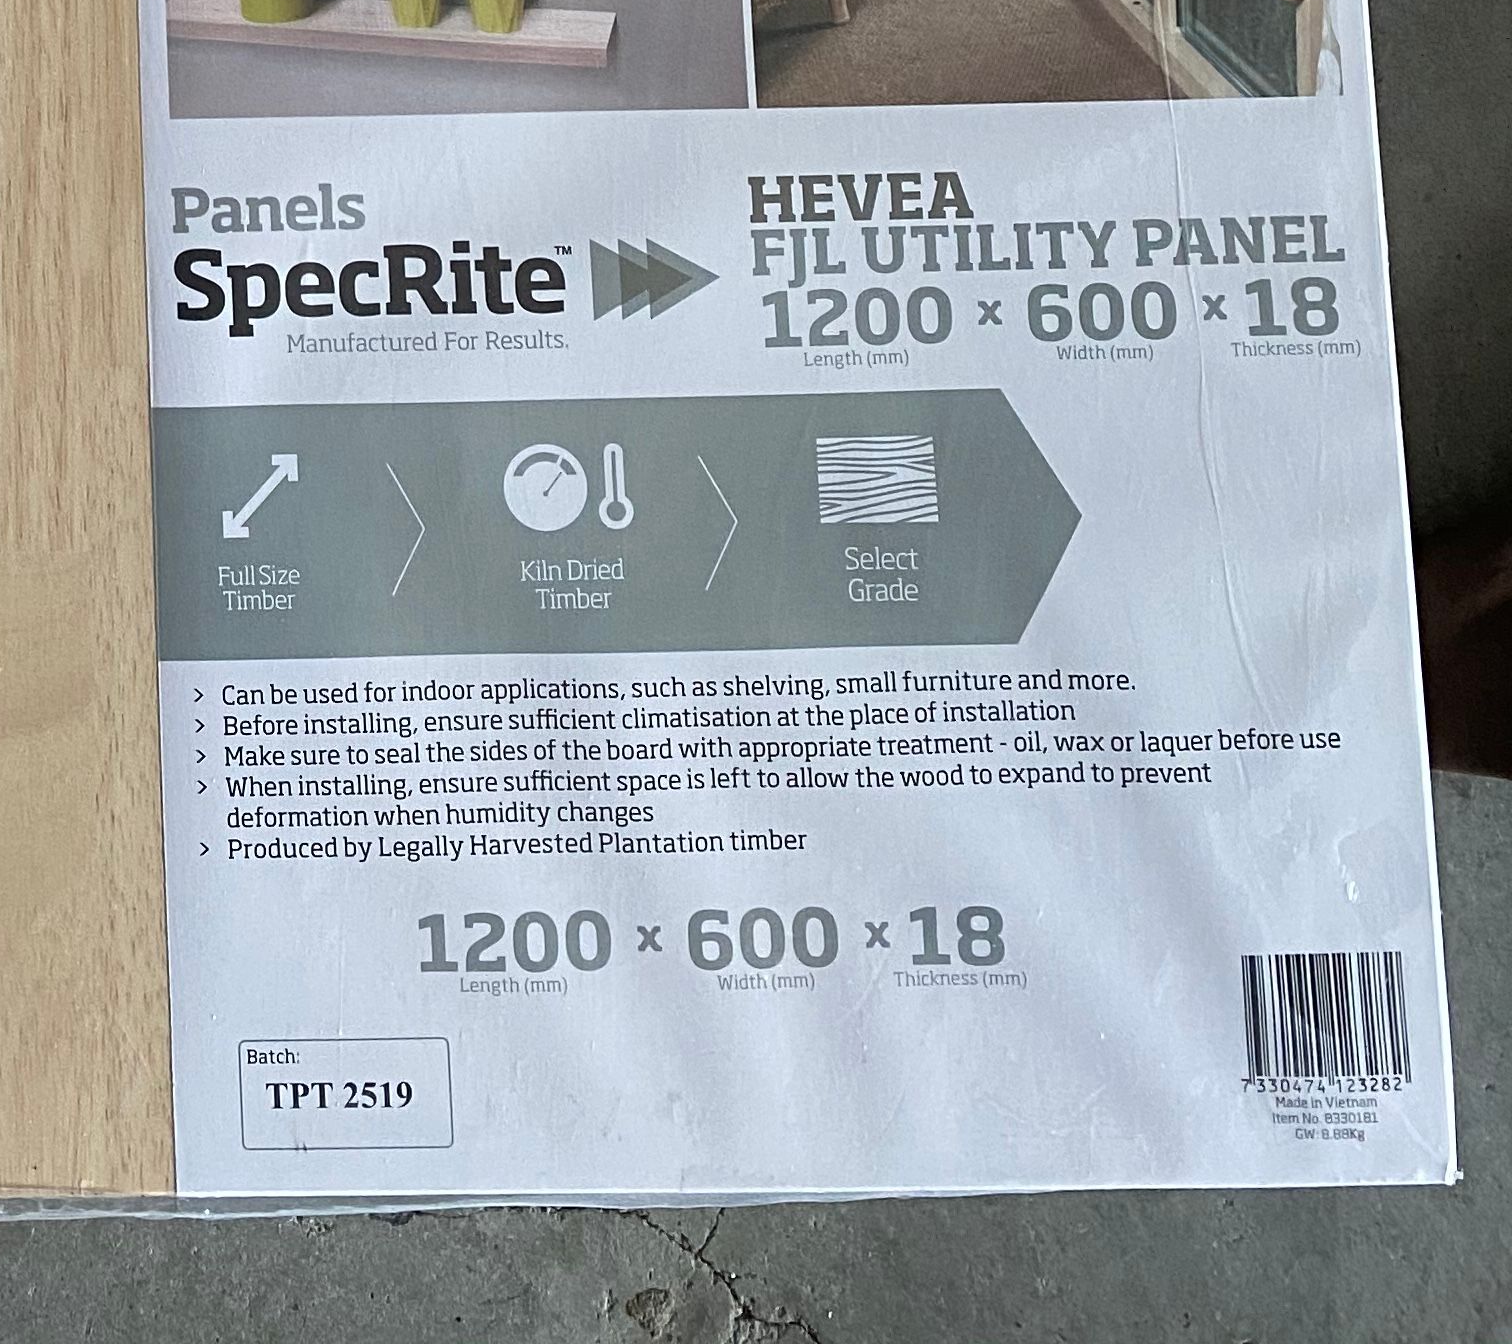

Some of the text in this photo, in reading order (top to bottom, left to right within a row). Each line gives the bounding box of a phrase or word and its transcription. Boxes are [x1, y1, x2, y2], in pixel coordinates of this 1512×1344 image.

[171, 183, 365, 233] Panels
[748, 172, 974, 223] HEVEA
[751, 215, 1345, 288] FJL UTILITY PANEL
[763, 286, 952, 348] 1200
[1028, 281, 1176, 342] 600
[1246, 277, 1339, 336] 18
[286, 328, 569, 354] Manufactured For Results.
[1056, 344, 1154, 363] Width (mm)
[1230, 338, 1362, 358] Thickness (mm)
[803, 348, 909, 370] Length (mm)
[520, 557, 625, 582] Kiln Dried
[844, 546, 919, 571] Select
[218, 564, 301, 587] Full Size
[222, 588, 297, 611] Timber
[535, 586, 613, 610] Timber
[848, 577, 919, 602] Grade
[222, 668, 1136, 706] Can be used for indoor applications, such as shelving, small furniture and more.
[223, 699, 1076, 738] Before installing, ensure sufficient climatisation at the place of installation
[224, 727, 1341, 767] Make sure to seal the sides of the board with appropriate treatment oil, wax or laquer before use
[225, 760, 1213, 801] When installing, ensure sufficient space is left to allow the wood to expand to prevent
[227, 800, 654, 829] deformation when humidity changes
[227, 828, 808, 863] Produced by Legally Harvested Plantation timber
[419, 910, 611, 973] 1200
[688, 907, 838, 971] 600
[910, 906, 1005, 966] 18
[460, 976, 568, 997] Length (mm)
[716, 971, 815, 992] Width (mm)
[892, 969, 1028, 990] Thickness (mm)
[246, 1047, 300, 1065] Batch:
[265, 1081, 413, 1110] TPT 2519
[1275, 1096, 1378, 1109] Made in Vietnam
[1272, 1113, 1300, 1125] Item
